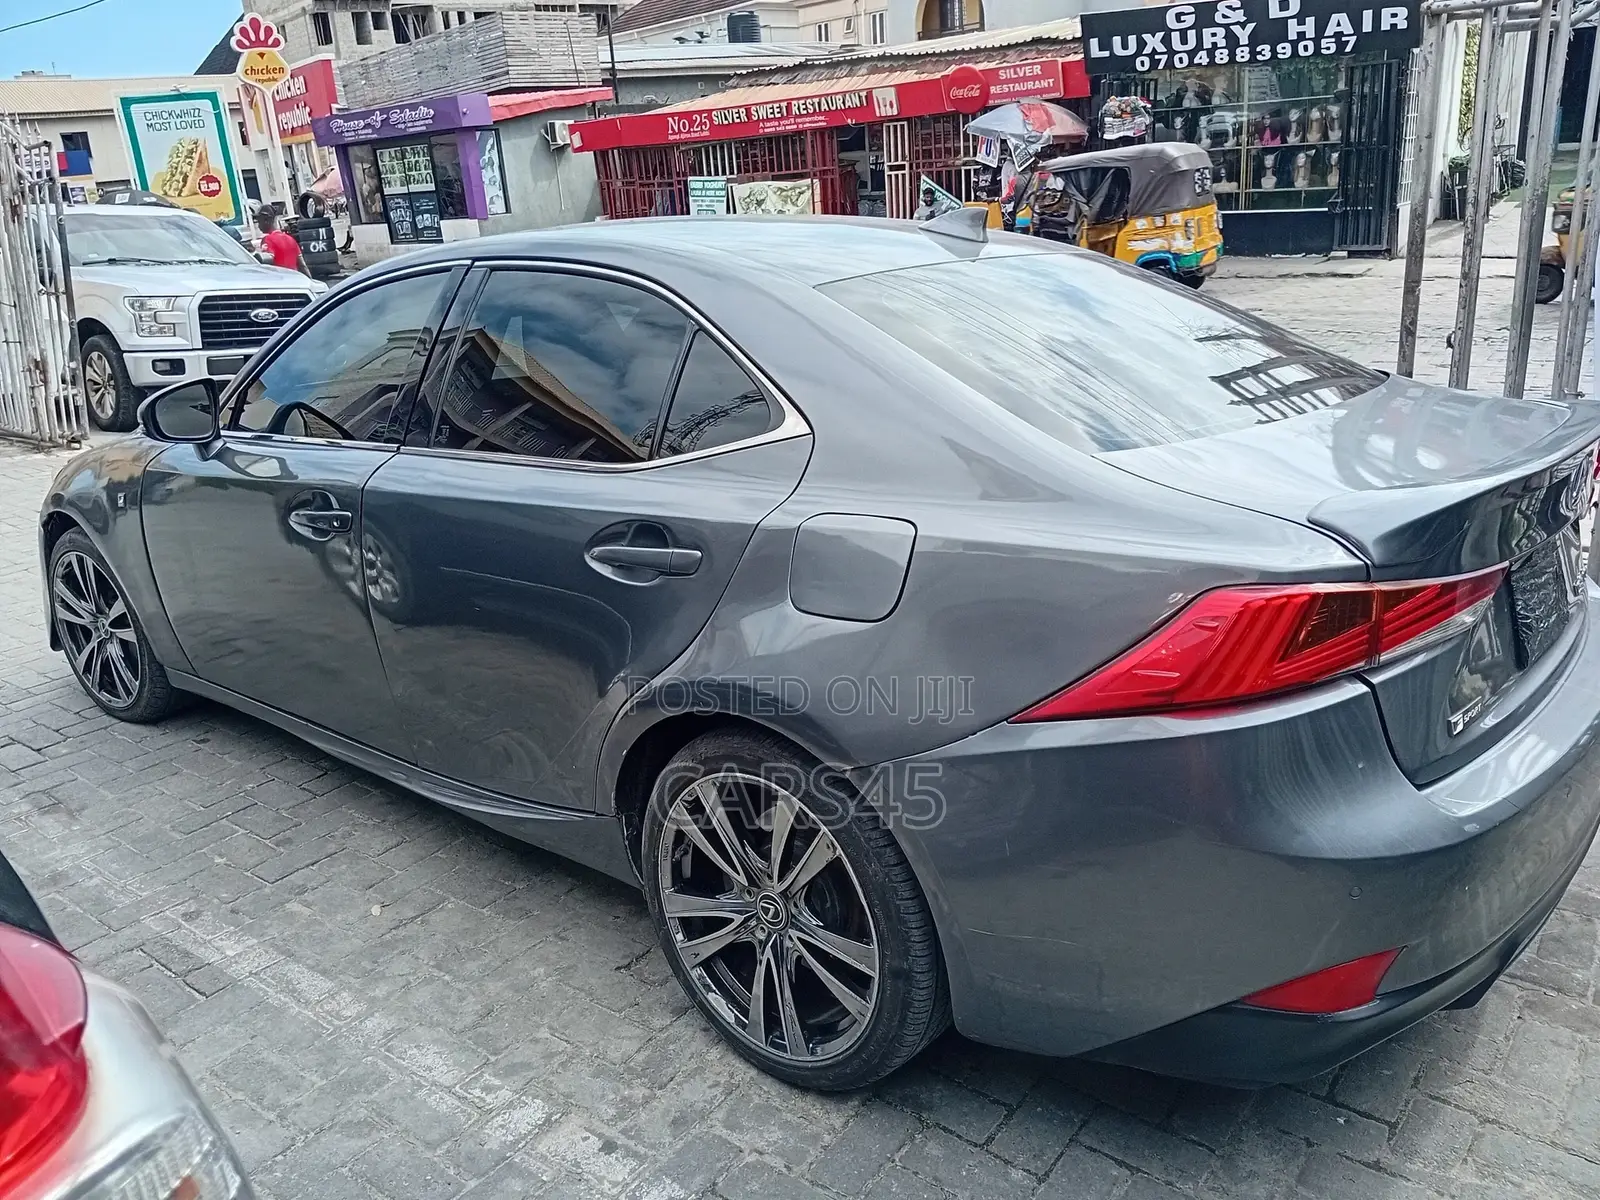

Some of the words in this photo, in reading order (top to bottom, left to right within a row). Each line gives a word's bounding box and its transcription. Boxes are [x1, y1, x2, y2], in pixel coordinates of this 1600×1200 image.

[1166, 5, 1196, 30] G
[1214, 0, 1248, 24] &
[1268, 0, 1301, 19] D
[1089, 22, 1257, 58] LUXURY
[1287, 7, 1408, 40] HAIR
[1135, 36, 1357, 71] 07048839057
[244, 65, 285, 76] chicken
[998, 65, 1042, 80] SILVER
[274, 75, 306, 101] chicken
[989, 78, 1054, 94] RESTAURANT
[144, 108, 202, 121] CHICKWHIZZ
[277, 101, 312, 134] republic
[667, 113, 710, 133] No.25
[711, 107, 748, 125] SILVER
[751, 103, 788, 121] SWEET
[791, 91, 868, 116] RESTAURANT
[146, 122, 172, 132] MOST
[175, 119, 205, 130] LOVED
[330, 118, 364, 133] House
[310, 241, 327, 252] OK
[1464, 703, 1482, 723] SPORT
